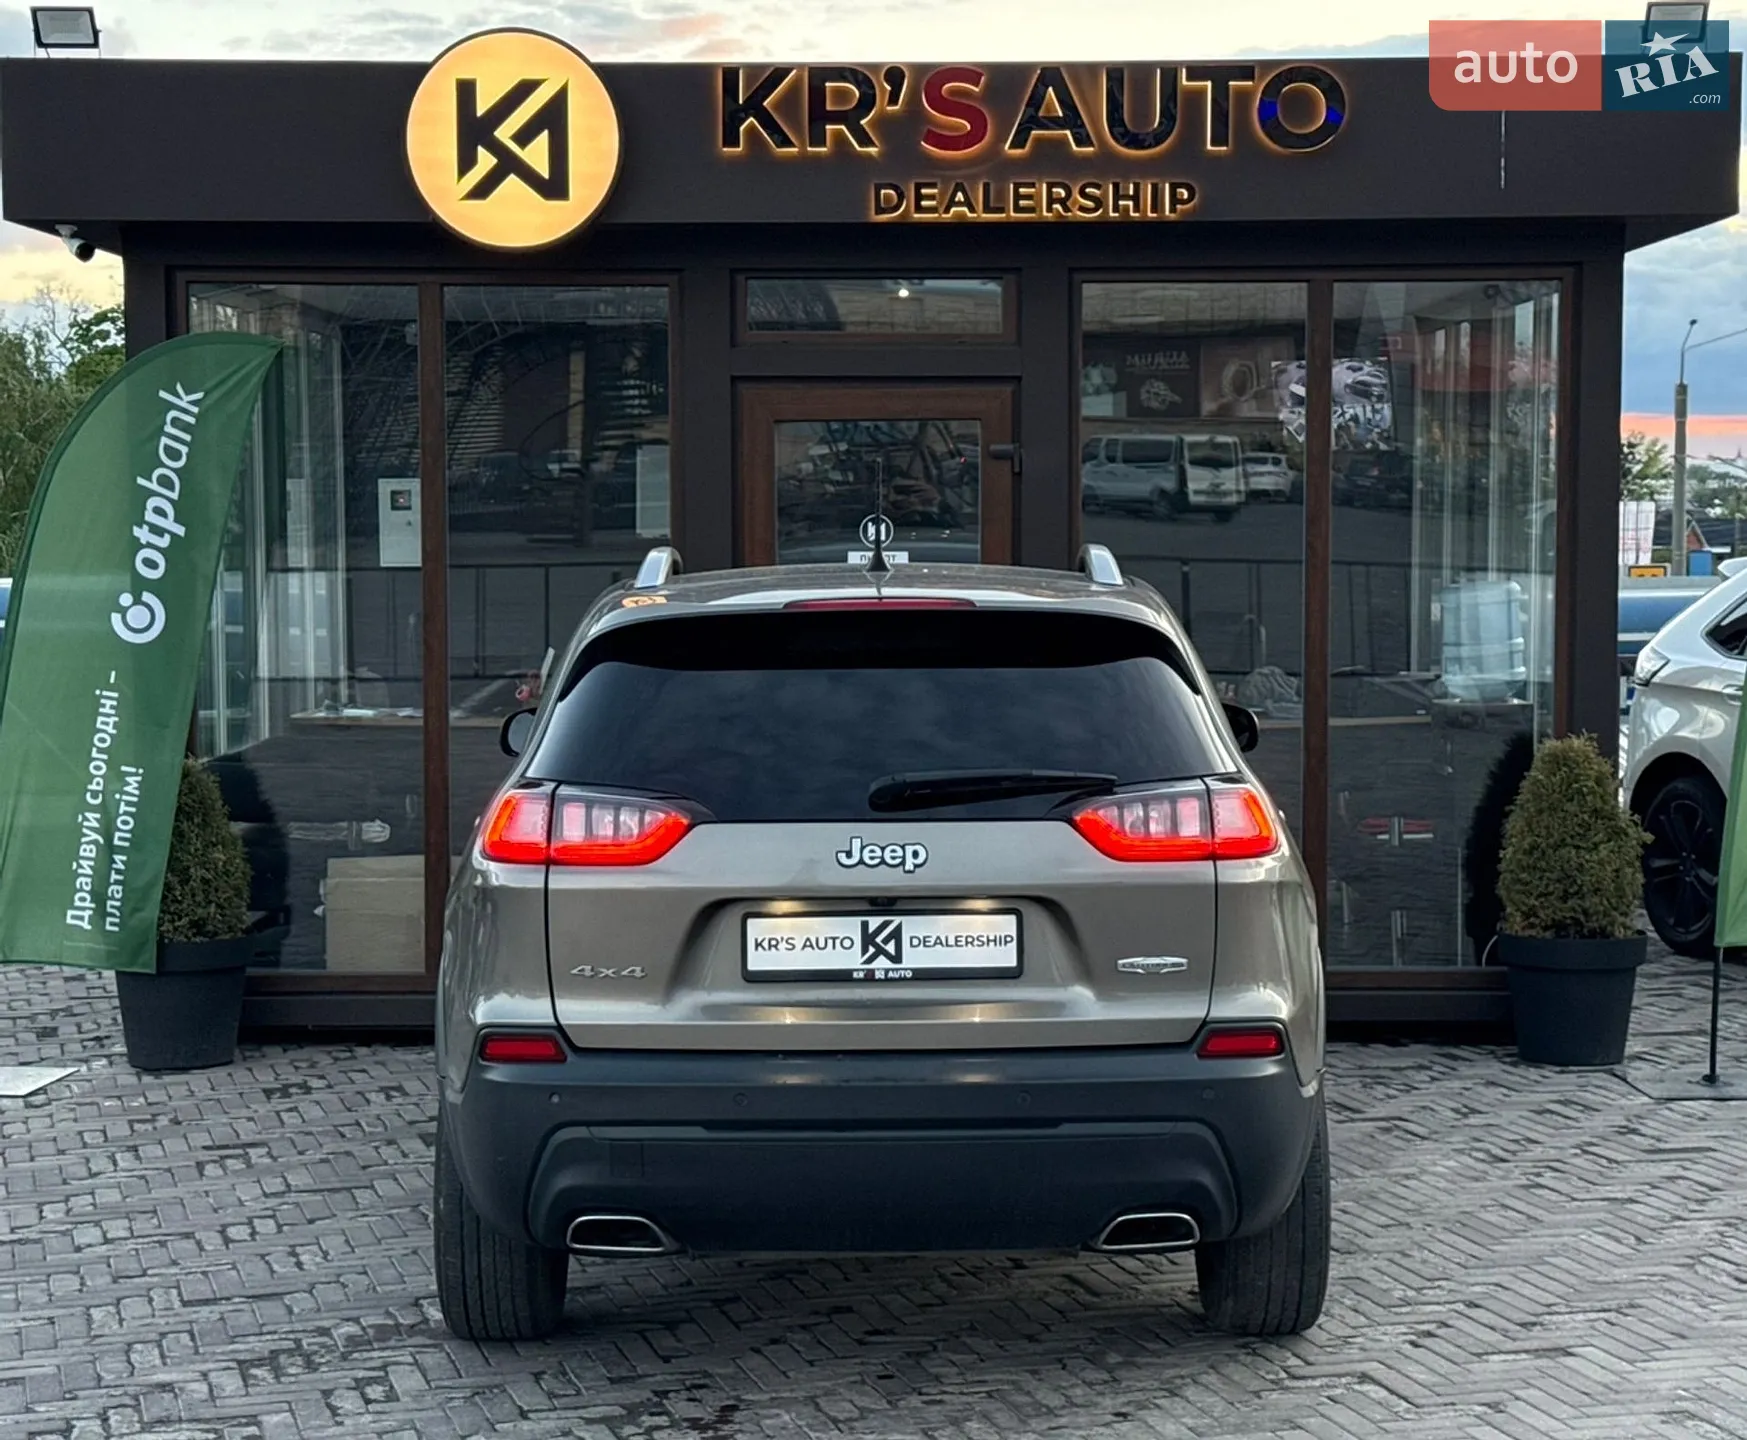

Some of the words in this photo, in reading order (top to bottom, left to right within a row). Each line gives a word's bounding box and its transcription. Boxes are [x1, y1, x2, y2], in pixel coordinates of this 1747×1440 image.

[720, 66, 989, 153] KR'S
[1005, 66, 1347, 153] AUTO
[873, 182, 1198, 219] DEALERSHIP
[132, 381, 205, 580] otpbank
[66, 812, 104, 931] Драйвуй
[85, 689, 119, 806] сьогодні
[113, 765, 145, 848] потім!
[836, 836, 928, 873] Jeep
[105, 855, 128, 933] плати
[754, 935, 797, 952] KR'S
[801, 935, 855, 951] AUTO
[909, 932, 1015, 948] DEALERSHIP
[569, 964, 647, 979] 4x4
[887, 969, 913, 978] AUTO
